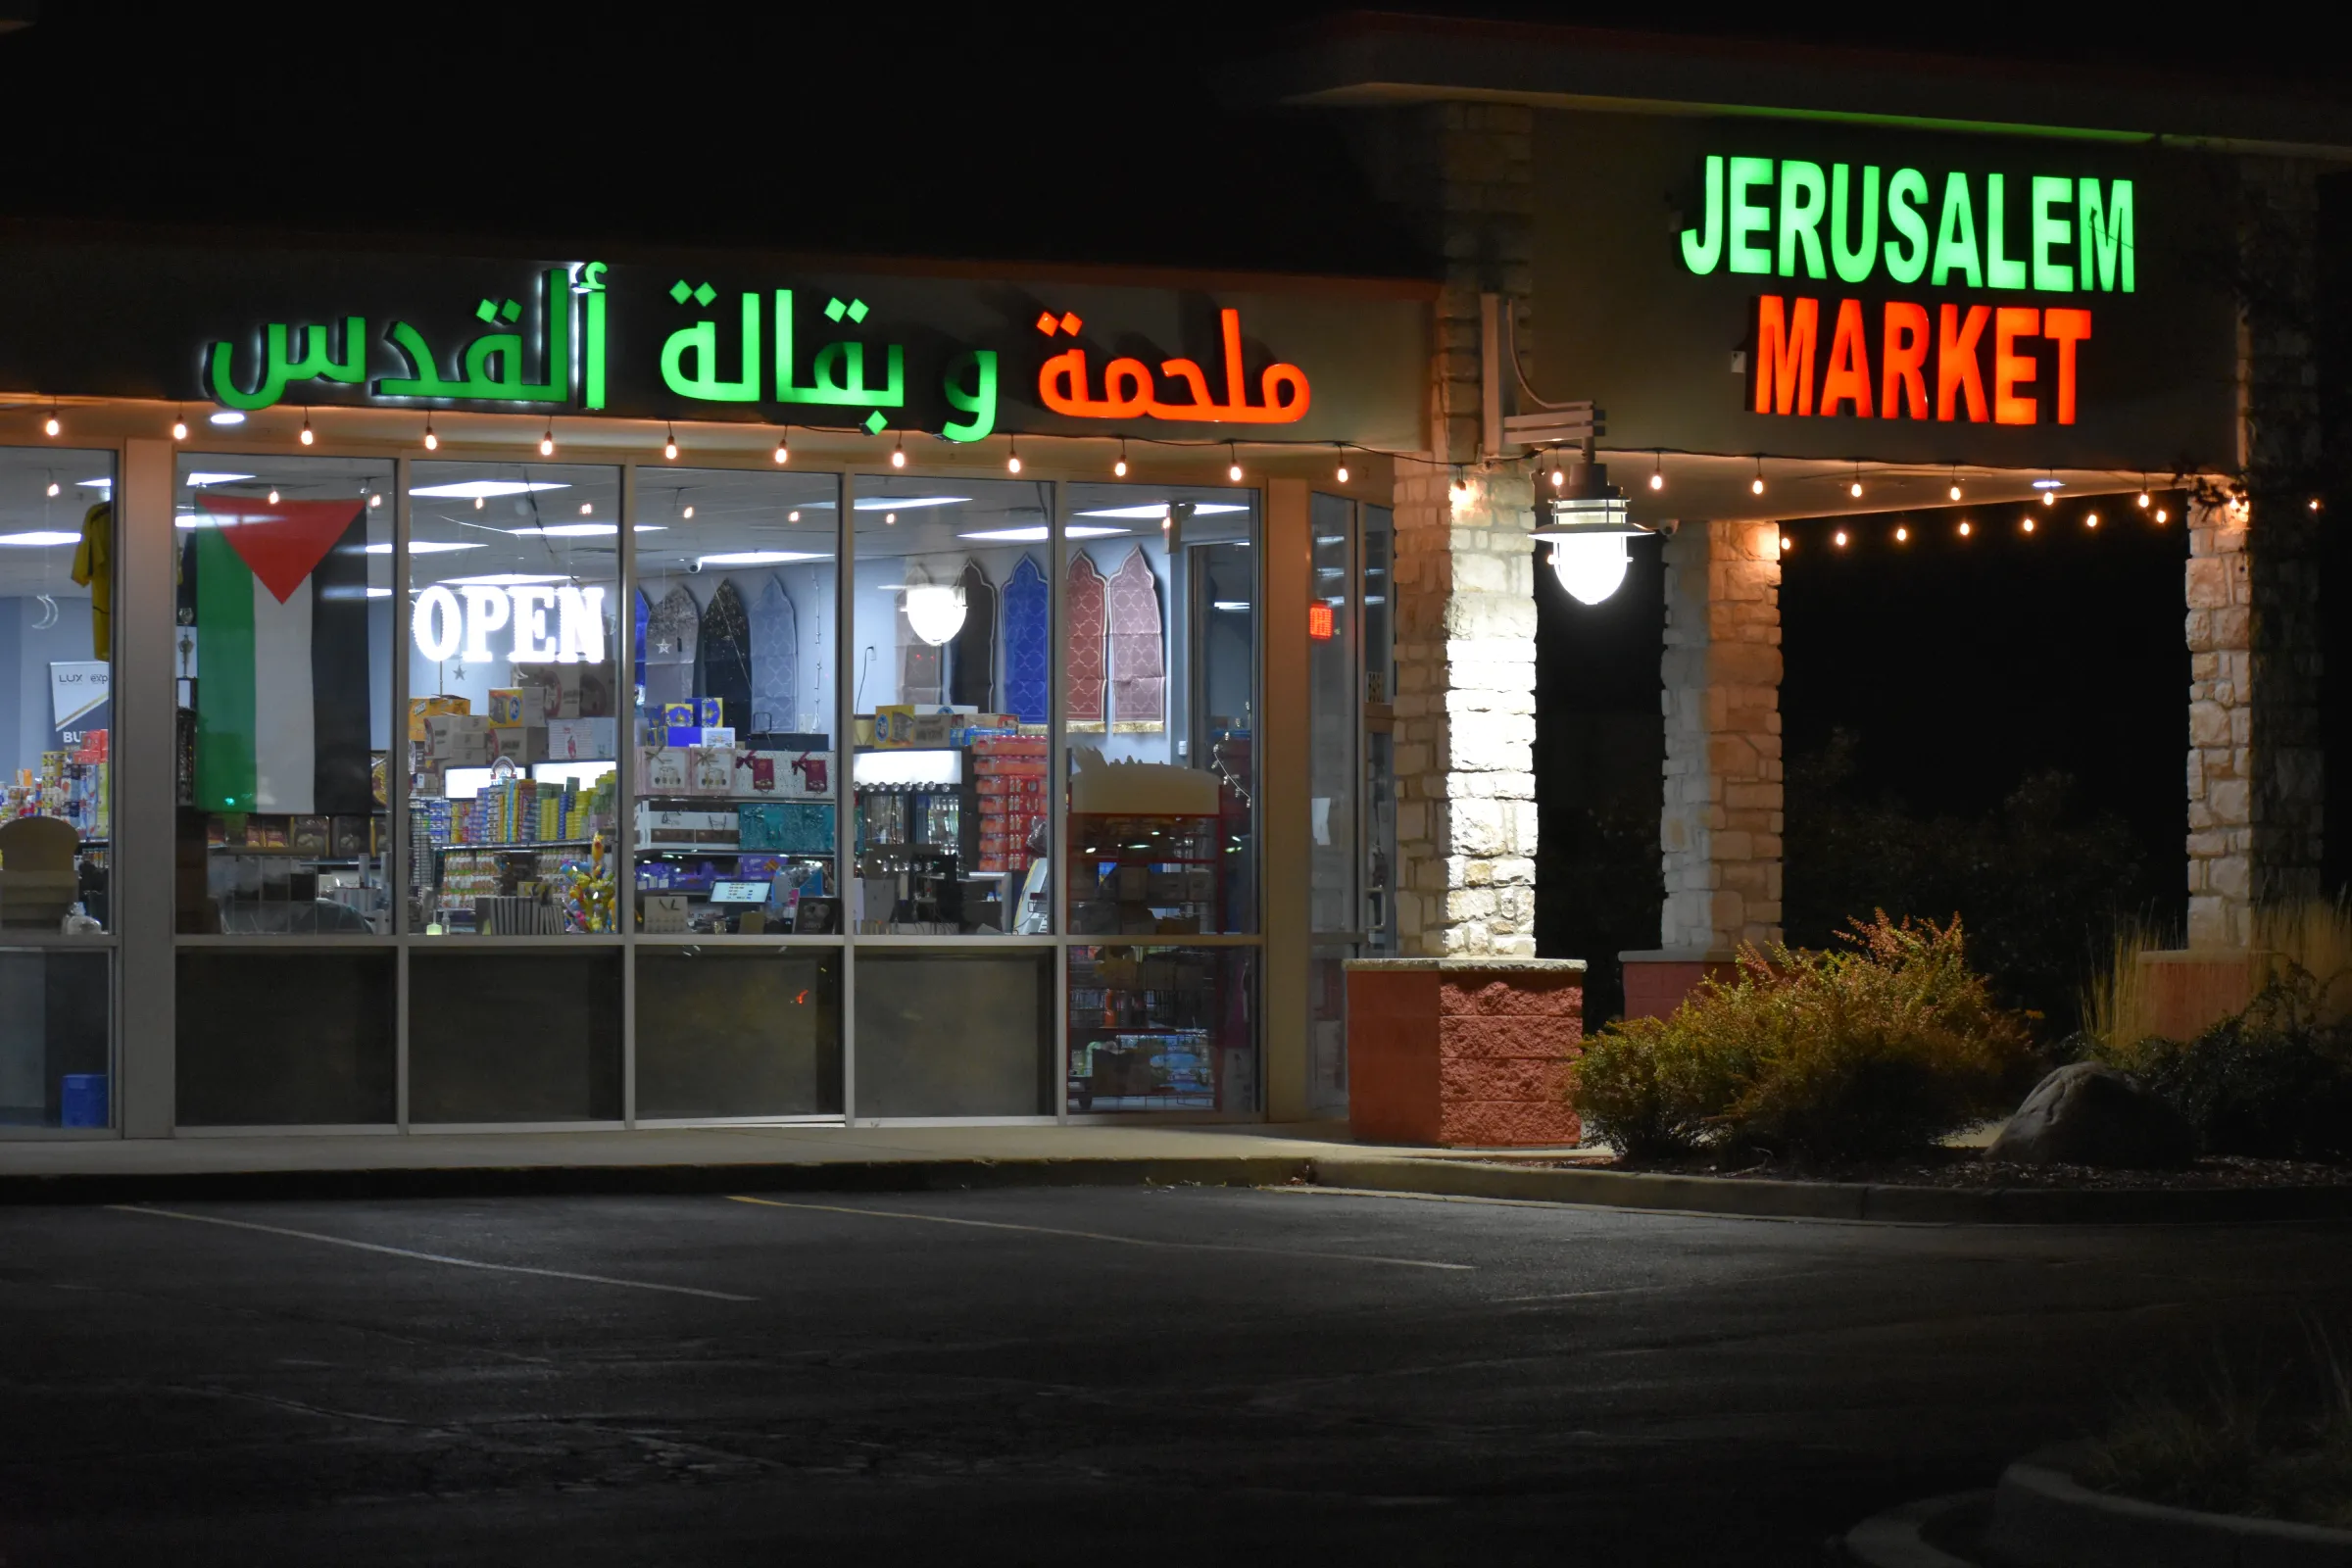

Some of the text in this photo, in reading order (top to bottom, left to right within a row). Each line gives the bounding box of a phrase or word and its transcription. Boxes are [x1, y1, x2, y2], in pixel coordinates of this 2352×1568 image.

[1681, 155, 2135, 293] JERUSALEM
[210, 261, 1311, 443] ملحمة و بقالة ألقدس
[1754, 294, 2092, 425] MARKET
[413, 585, 605, 663] OPEN
[59, 674, 82, 683] LUX
[63, 731, 86, 744] BU
